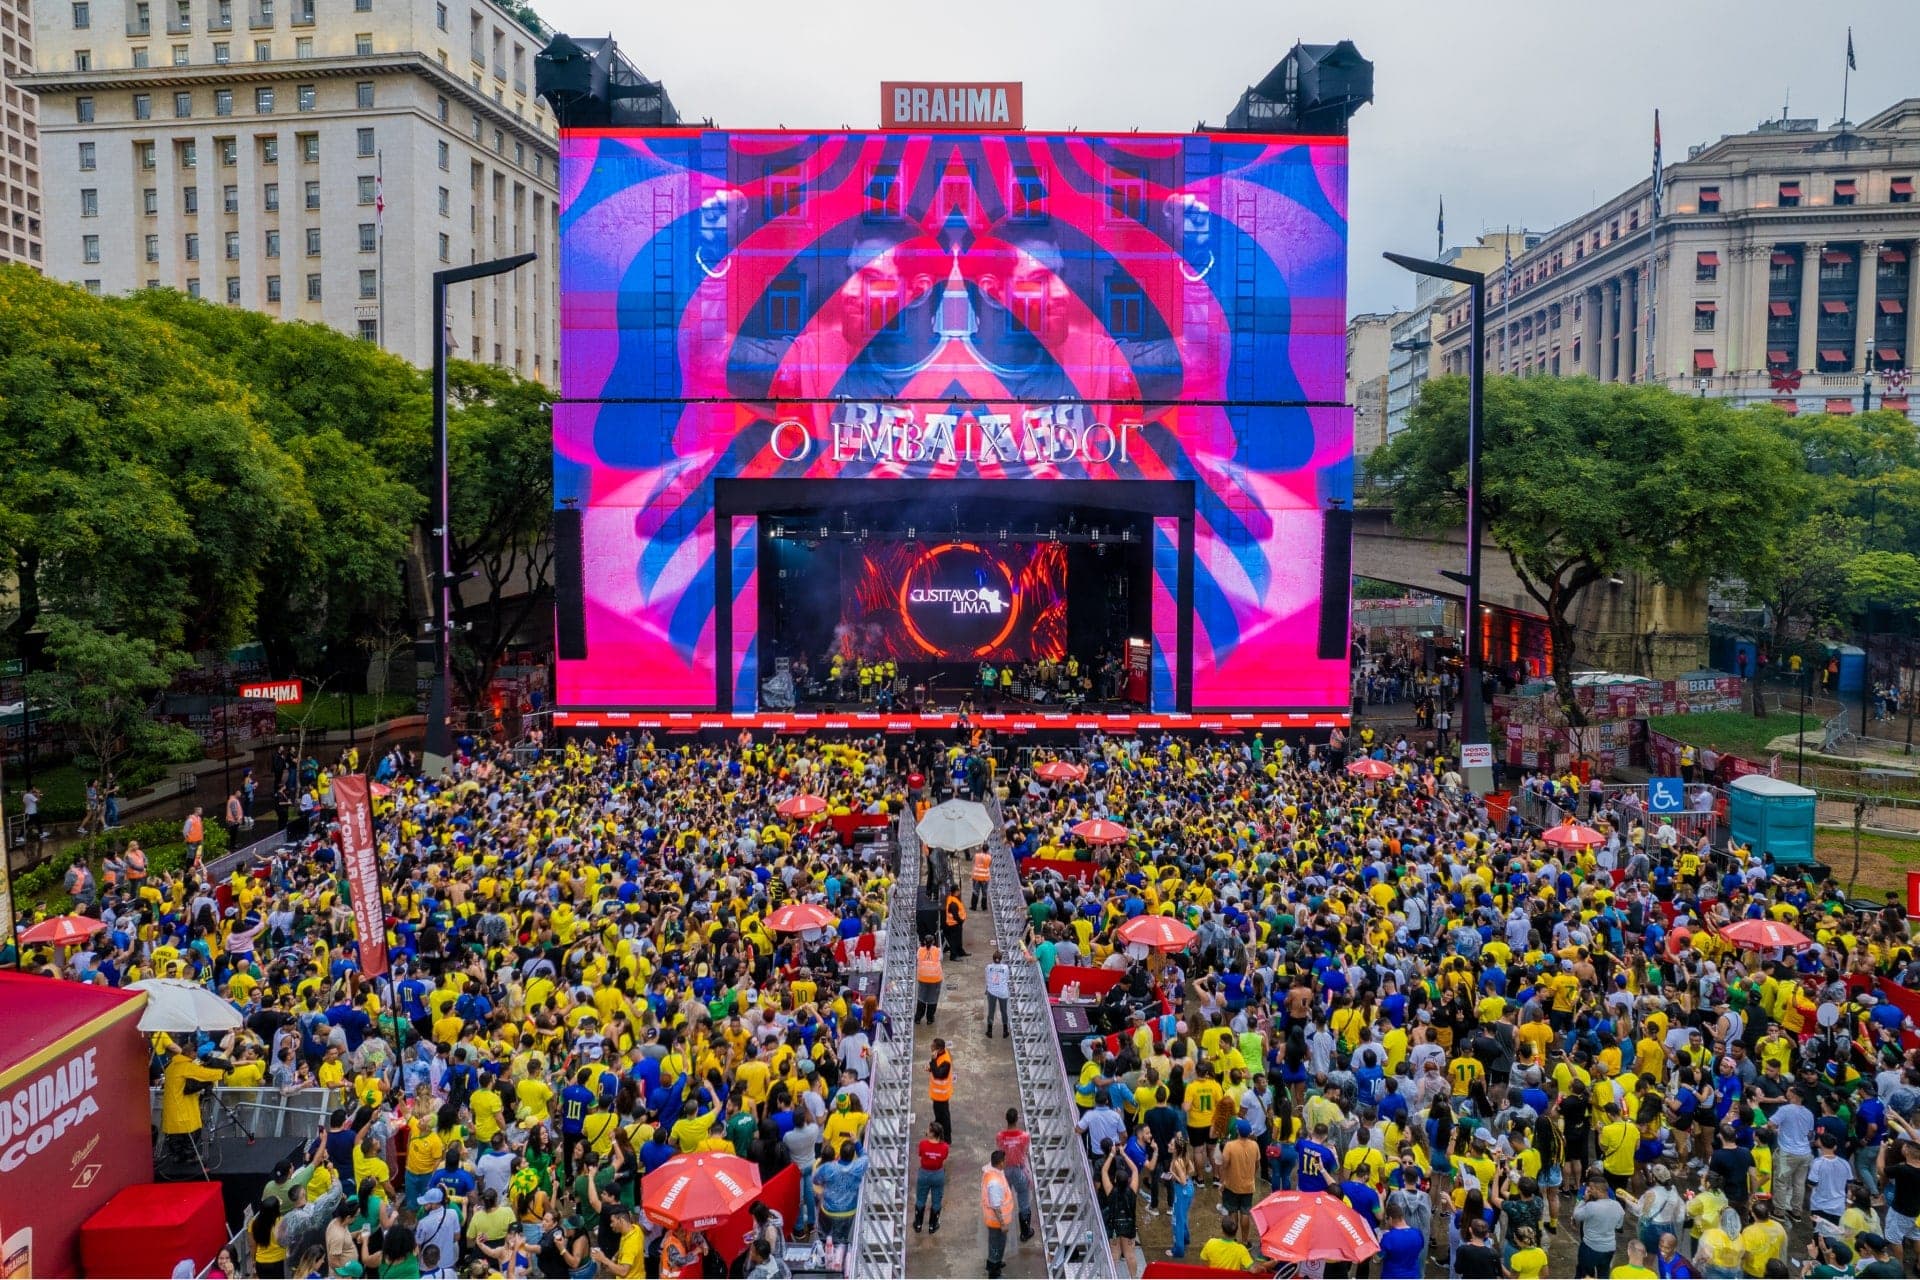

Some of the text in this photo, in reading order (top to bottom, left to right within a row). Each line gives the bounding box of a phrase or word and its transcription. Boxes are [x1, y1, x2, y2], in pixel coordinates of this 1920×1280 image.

[894, 88, 1010, 122] BRAHMA
[770, 420, 811, 461] O
[911, 589, 978, 602] GUSTTAVO
[953, 601, 989, 613] LIMA
[356, 802, 368, 846] NOSSA
[341, 812, 358, 879] TOMAR
[354, 899, 369, 943] COPA
[567, 1099, 581, 1120] 10
[0, 1095, 99, 1172] COPA
[660, 1175, 690, 1210] BRAHMA
[1282, 1213, 1312, 1246] BRAHMA
